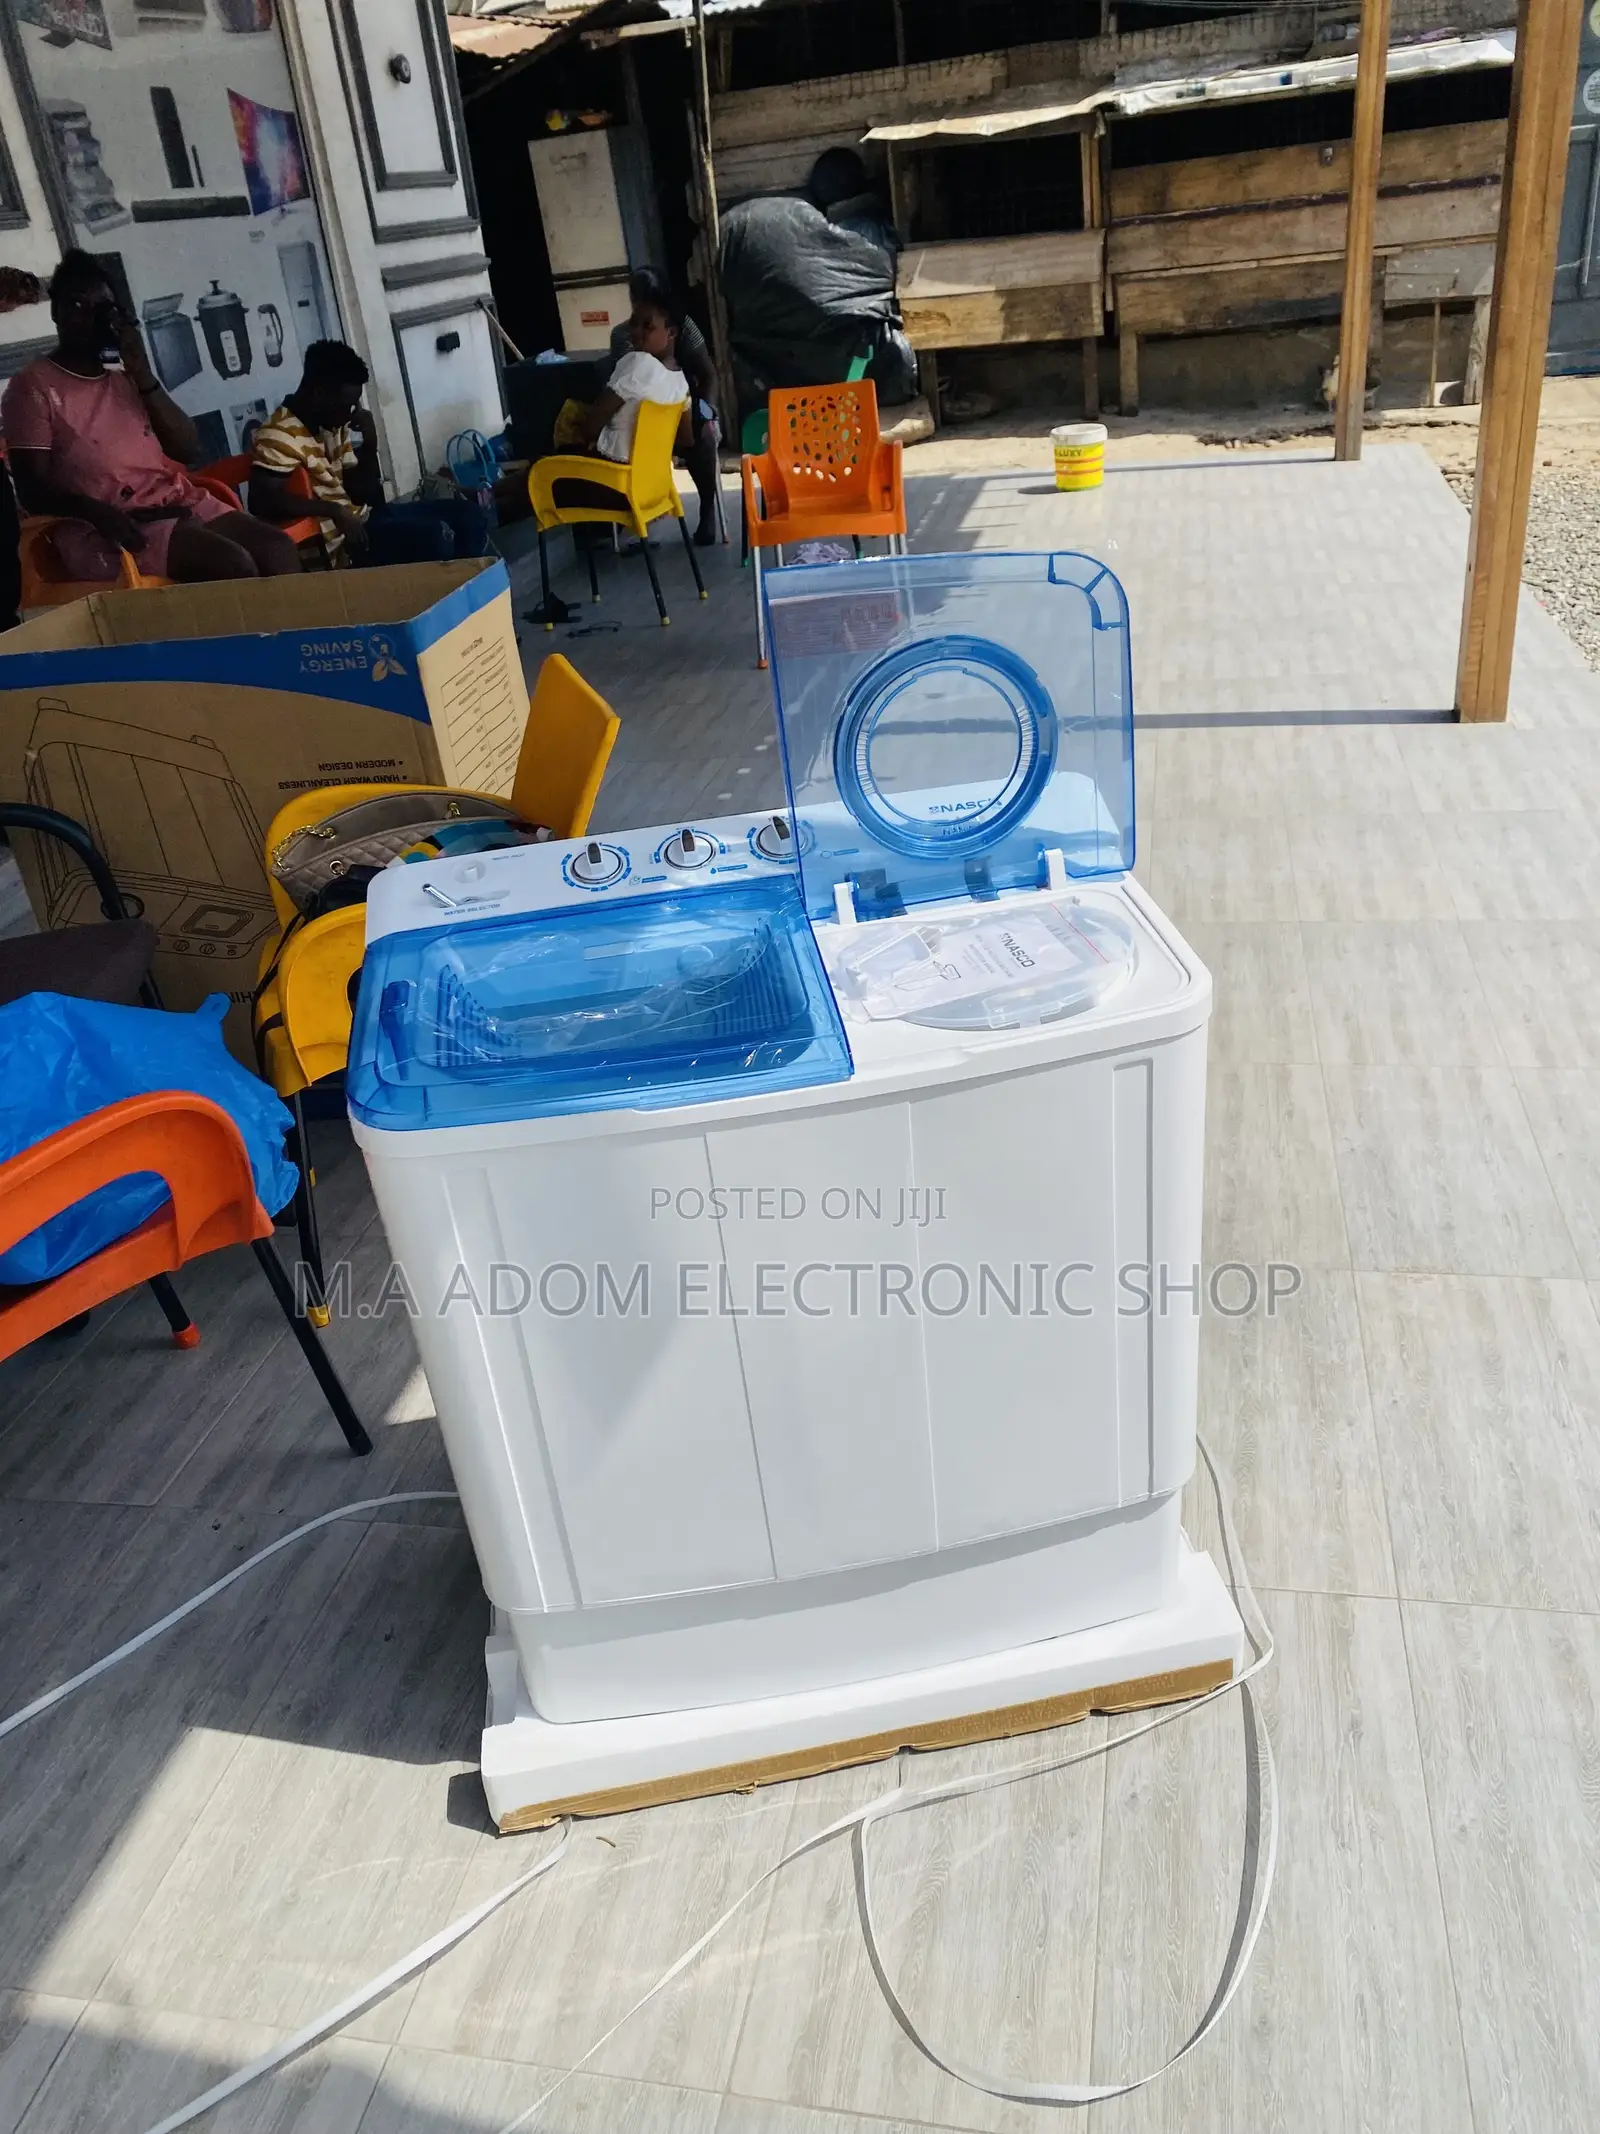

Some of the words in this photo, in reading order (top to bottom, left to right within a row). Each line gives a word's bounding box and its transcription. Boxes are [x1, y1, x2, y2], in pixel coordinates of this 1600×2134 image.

[300, 639, 364, 657] SAVING
[298, 655, 367, 673] ENERGY
[318, 761, 353, 772] DESIGN
[355, 759, 396, 770] MODERN
[278, 777, 341, 790] CLEANLINESS
[343, 776, 370, 786] WASH
[371, 774, 400, 785] HAND
[1001, 938, 1036, 968] NASCO
